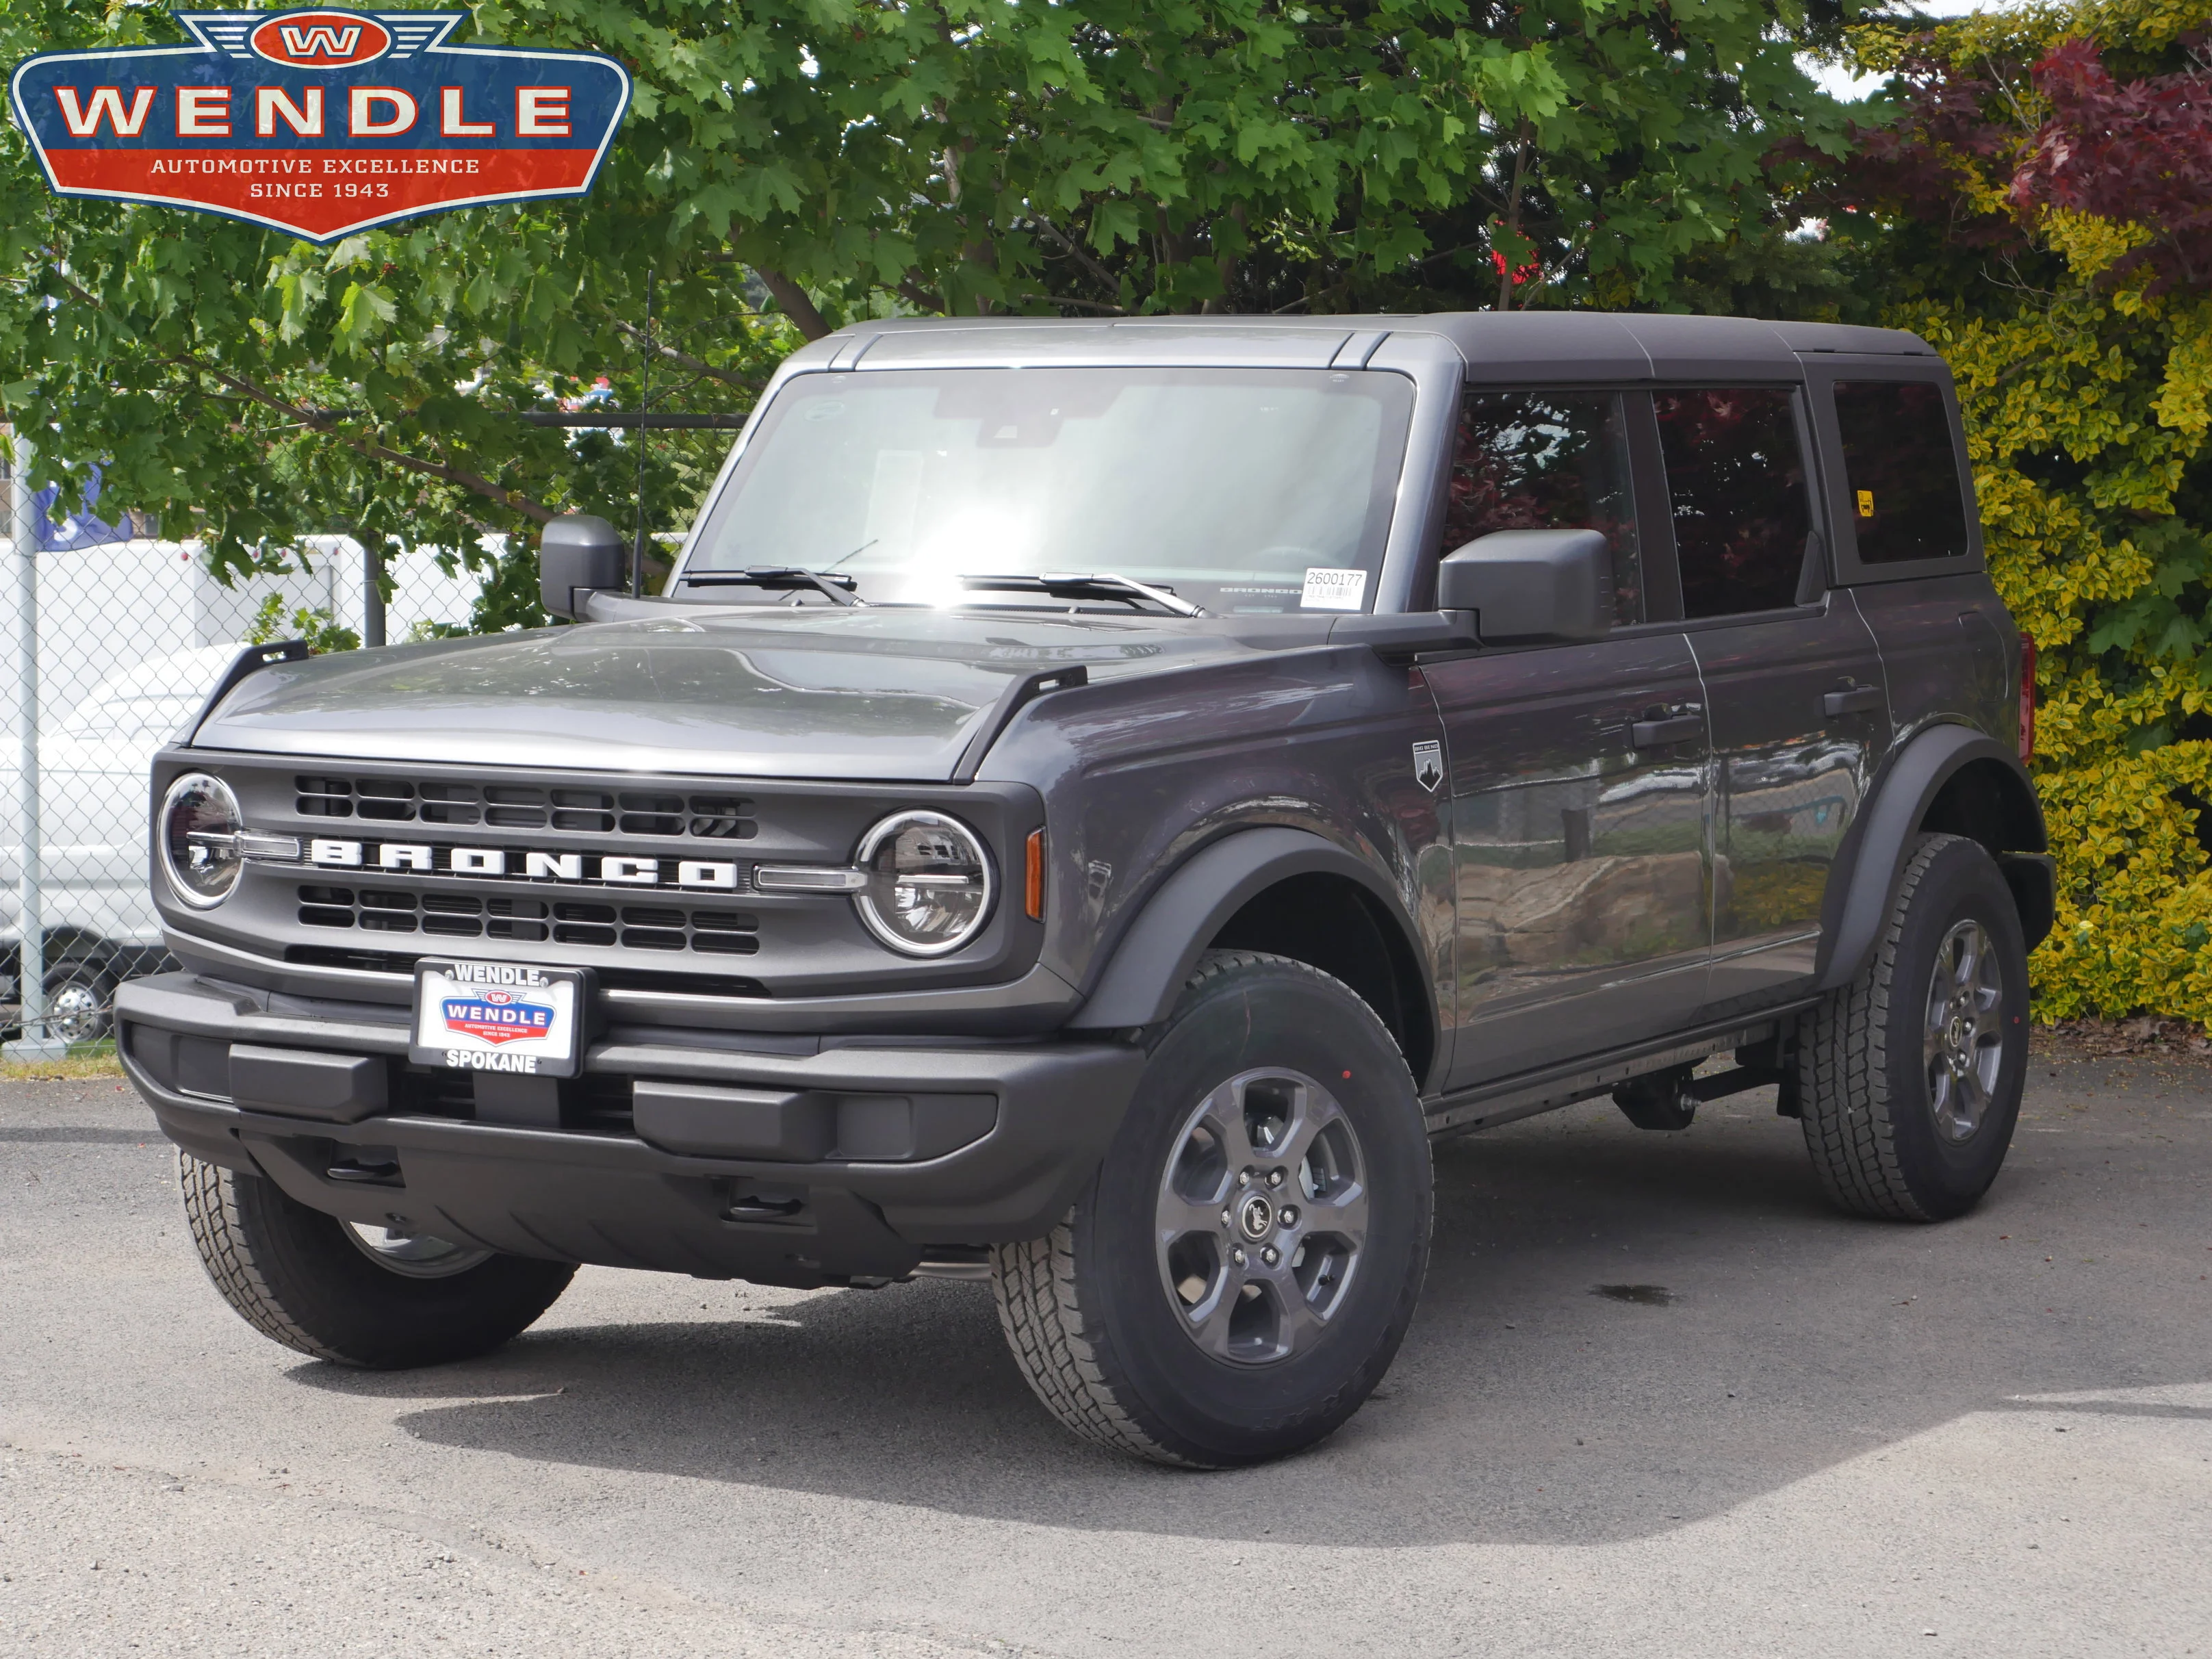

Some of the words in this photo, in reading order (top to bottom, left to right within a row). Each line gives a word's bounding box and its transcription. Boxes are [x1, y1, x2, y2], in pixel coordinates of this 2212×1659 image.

[1307, 572, 1362, 586] 2600177
[311, 839, 738, 889] BRONCO
[454, 964, 540, 986] WENDLE
[448, 1005, 545, 1025] WENDLE
[446, 1049, 536, 1073] SPOKANE
